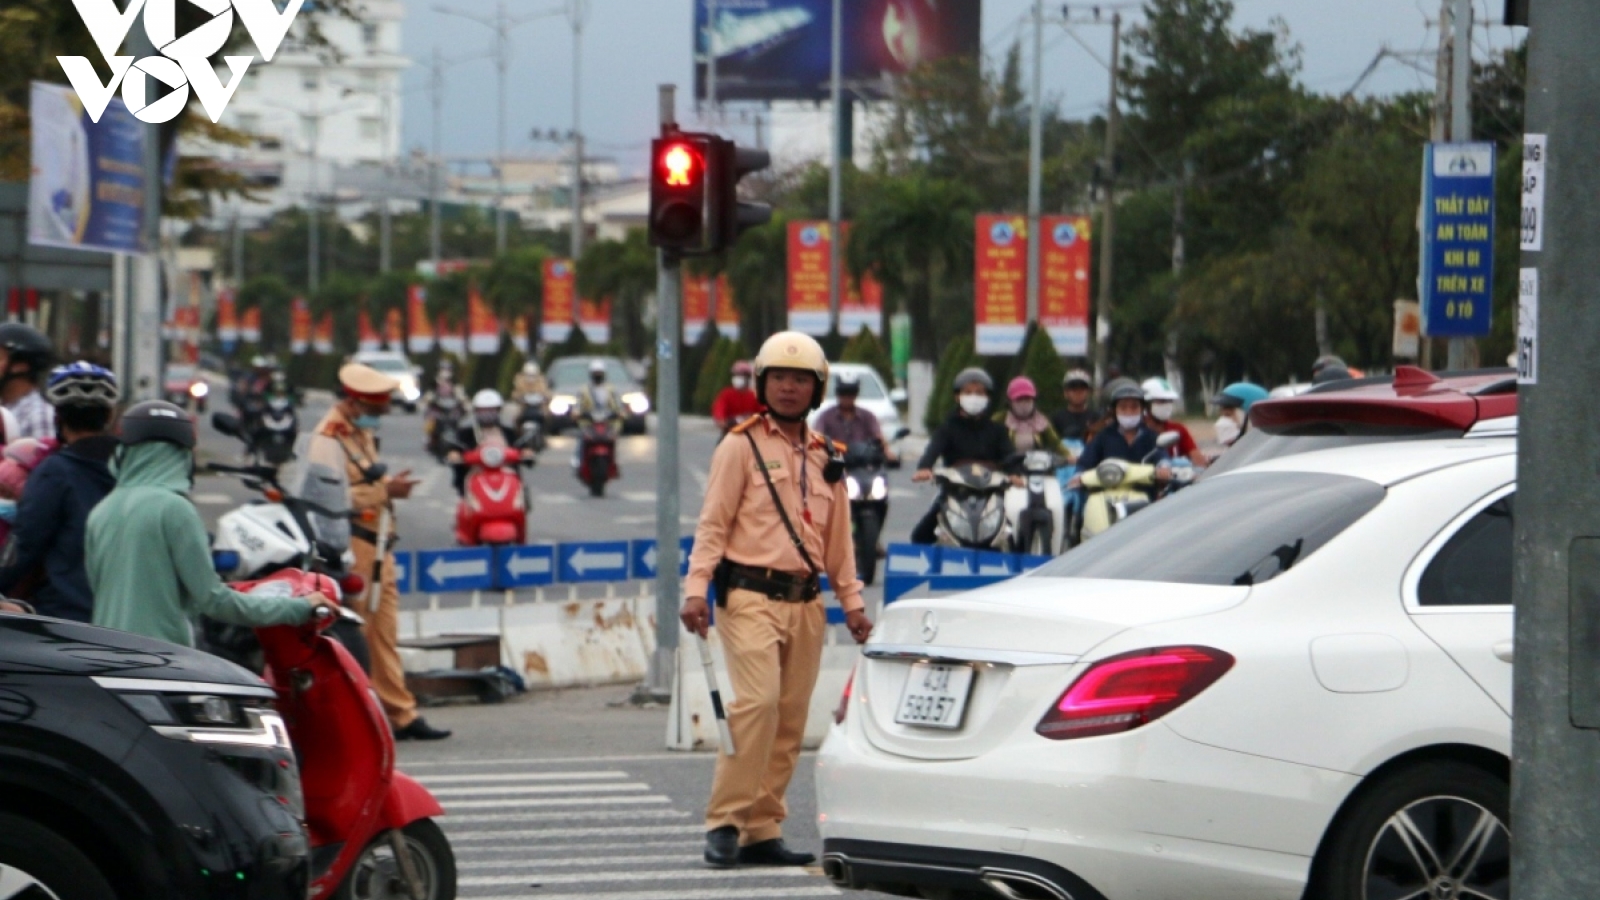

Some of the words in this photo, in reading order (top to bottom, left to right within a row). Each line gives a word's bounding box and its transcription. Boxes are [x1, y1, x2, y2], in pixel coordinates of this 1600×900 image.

[1437, 223, 1455, 241] AN
[1444, 250, 1465, 268] KHI
[1437, 273, 1468, 293] TRÊN
[1471, 275, 1485, 293] XE
[1446, 299, 1456, 318] Ô
[1459, 299, 1473, 318] TÔ
